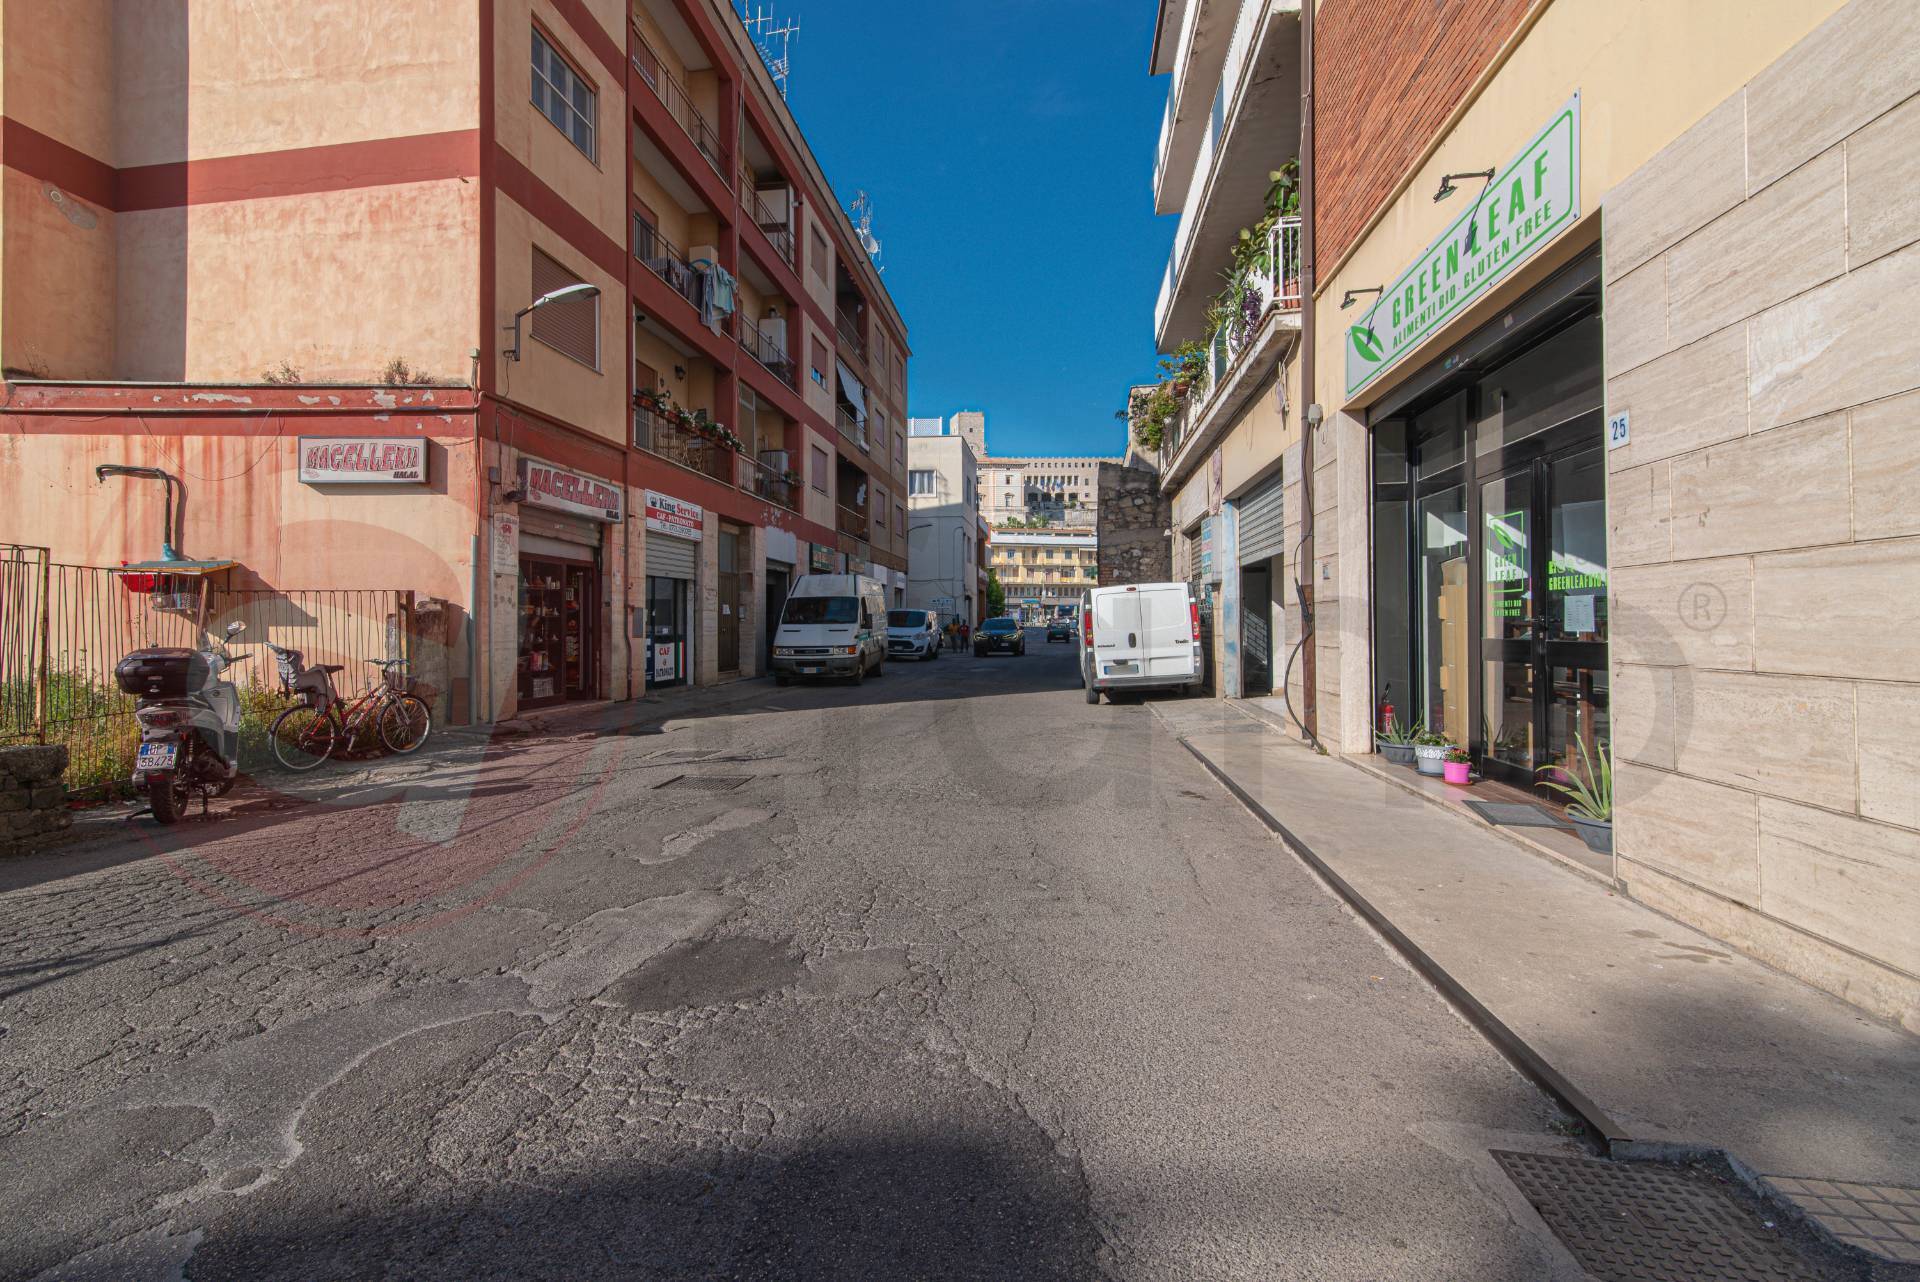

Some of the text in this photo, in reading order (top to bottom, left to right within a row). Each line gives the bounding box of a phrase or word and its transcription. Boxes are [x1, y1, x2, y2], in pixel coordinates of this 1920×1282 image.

[1392, 150, 1548, 328] GREEN LEAF
[1393, 302, 1436, 349] ALIMENTI
[1438, 284, 1456, 311] BIO
[1463, 236, 1510, 289] GLUTEN
[1516, 200, 1551, 245] FREE
[1612, 418, 1626, 440] 25
[306, 443, 419, 472] MACELLERIA
[659, 497, 676, 514] King
[659, 646, 670, 656] CAF
